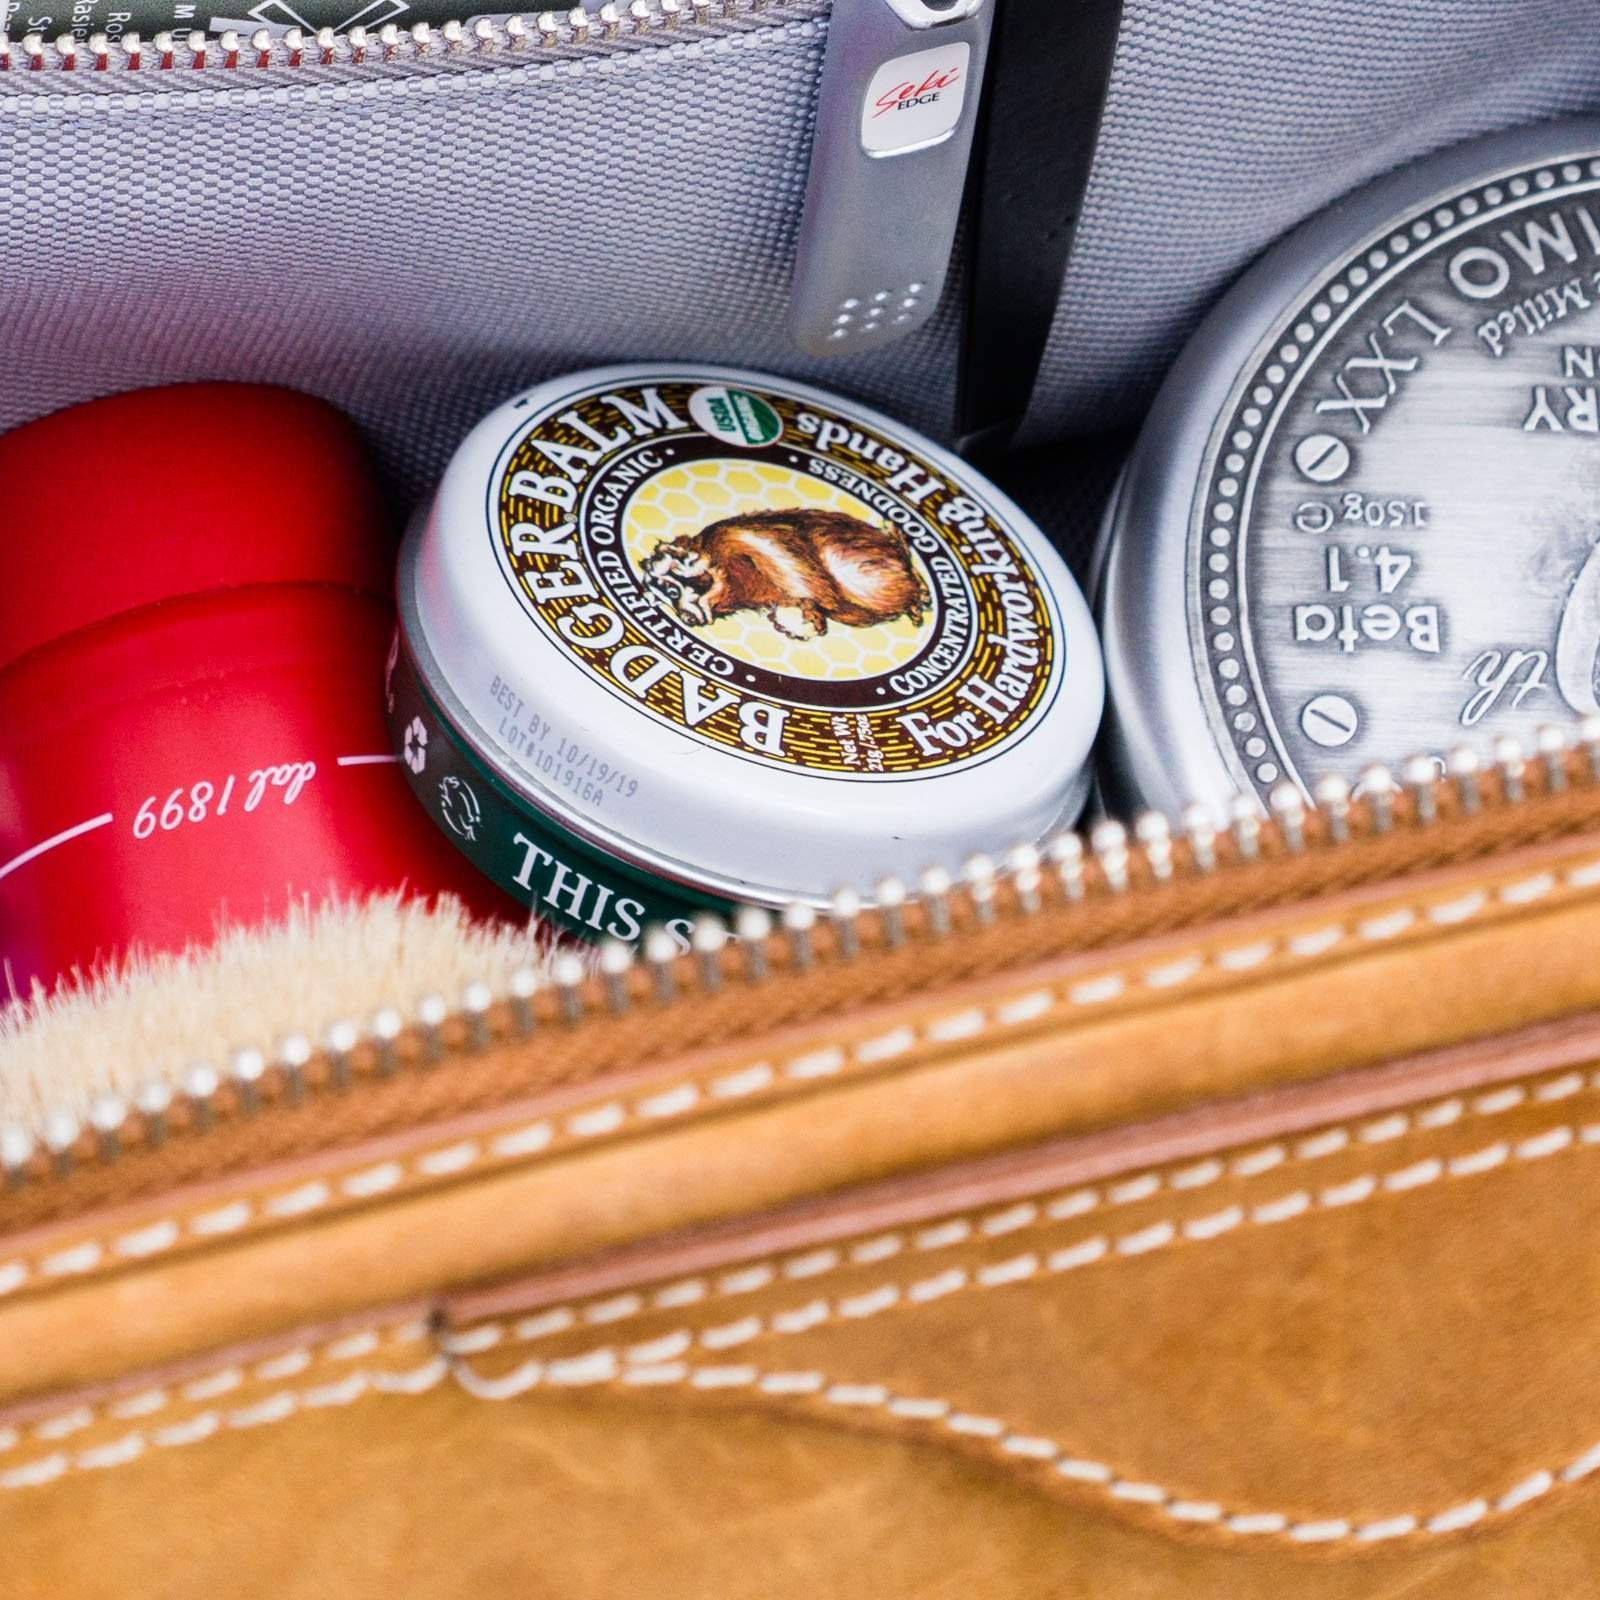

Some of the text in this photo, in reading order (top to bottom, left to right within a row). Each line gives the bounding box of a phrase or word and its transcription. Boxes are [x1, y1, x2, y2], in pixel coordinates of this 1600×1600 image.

[871, 66, 960, 119] Seki
[896, 91, 941, 111] EDGE
[1477, 280, 1593, 357] Milled
[508, 387, 689, 513] BALM
[589, 449, 735, 677] CERTIFIED ORGANIC
[796, 411, 1041, 757] For Hardworking Hands
[807, 457, 970, 696] CONCENTRATED GOODNESS
[1326, 545, 1413, 594] 4.1
[1294, 604, 1442, 654] Beta
[489, 674, 639, 799] BEST BY 10/19/19
[840, 738, 861, 766] Net
[132, 761, 317, 840] dal 1899
[511, 830, 647, 943] THIS
